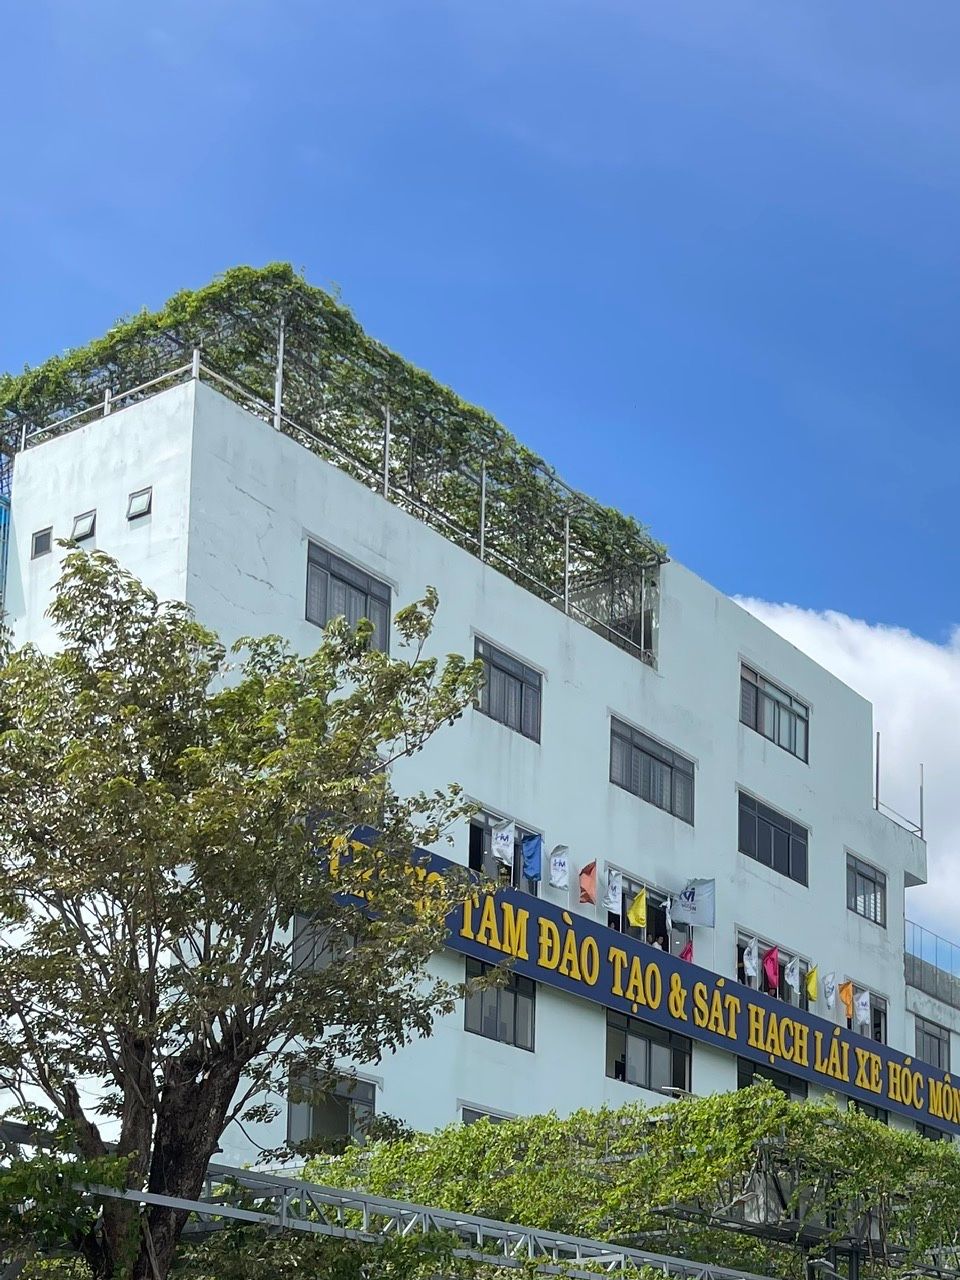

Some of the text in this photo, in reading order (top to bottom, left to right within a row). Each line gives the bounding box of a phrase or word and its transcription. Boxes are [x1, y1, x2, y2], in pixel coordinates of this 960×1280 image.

[538, 911, 600, 986] ĐÀO
[608, 946, 662, 1014] TẠO
[668, 972, 688, 1021] &
[693, 978, 741, 1040] SÁT
[747, 1003, 809, 1067] HẠCH
[814, 1026, 850, 1083] LÁI
[854, 1047, 883, 1094] XE
[887, 1057, 924, 1110] HÓC
